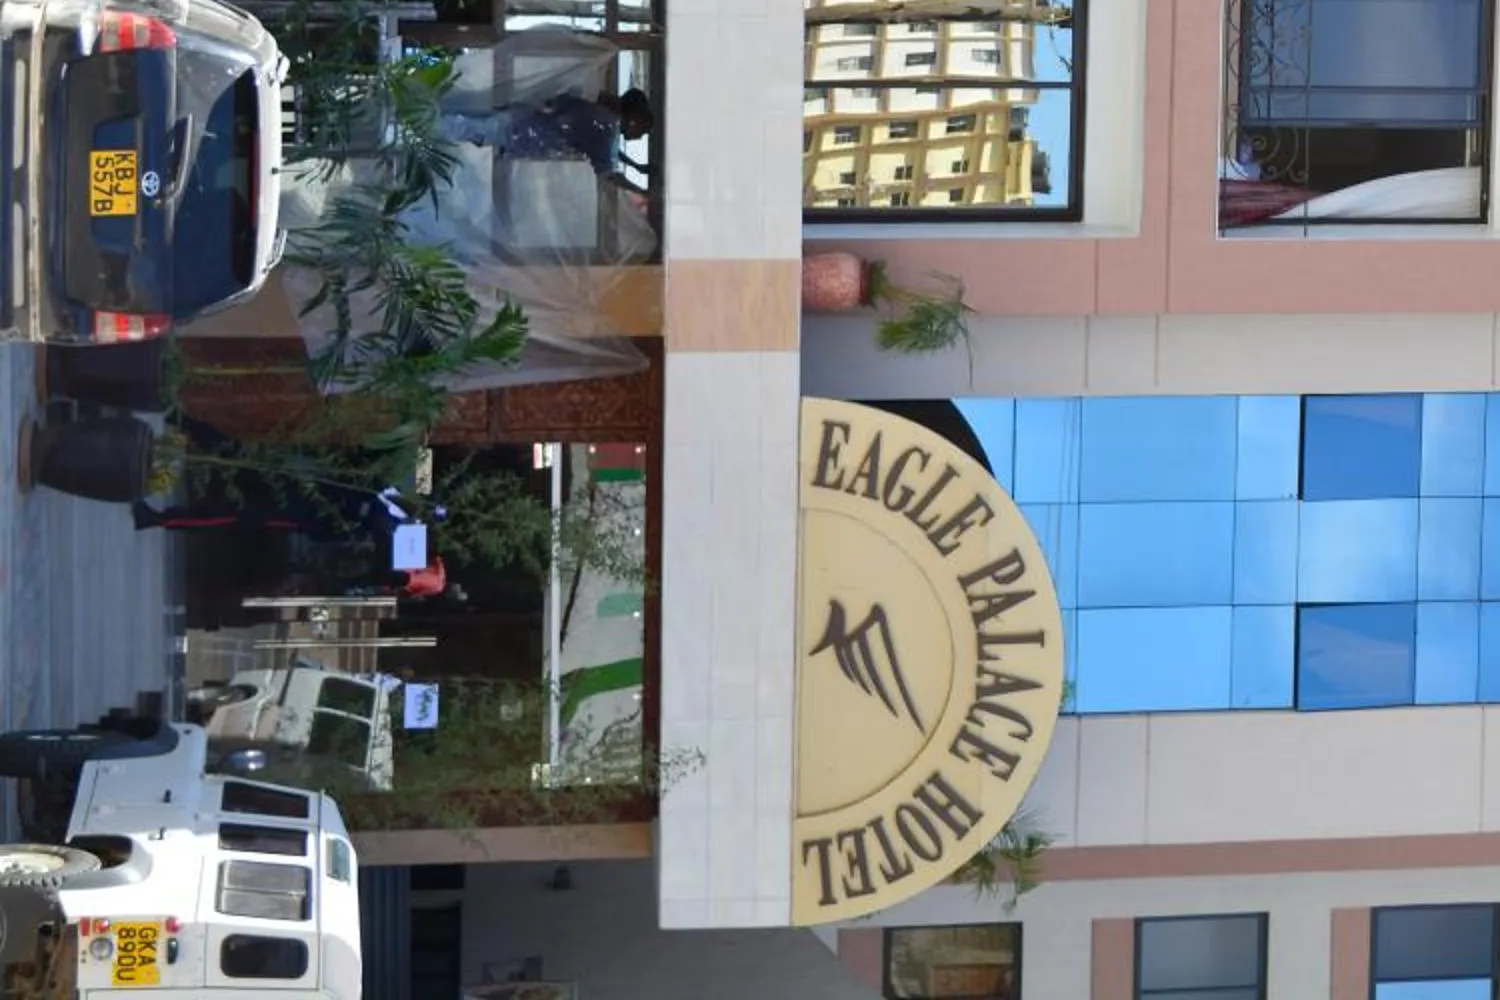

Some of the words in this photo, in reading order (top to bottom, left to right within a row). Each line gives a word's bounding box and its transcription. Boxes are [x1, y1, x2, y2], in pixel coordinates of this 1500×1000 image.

[93, 155, 115, 214] 557B
[114, 152, 135, 196] KBJ
[811, 419, 995, 558] EAGLE
[948, 547, 1046, 783] PALACE
[801, 769, 985, 907] HOTEL
[116, 926, 137, 982] 890U
[137, 926, 157, 968] GKA
